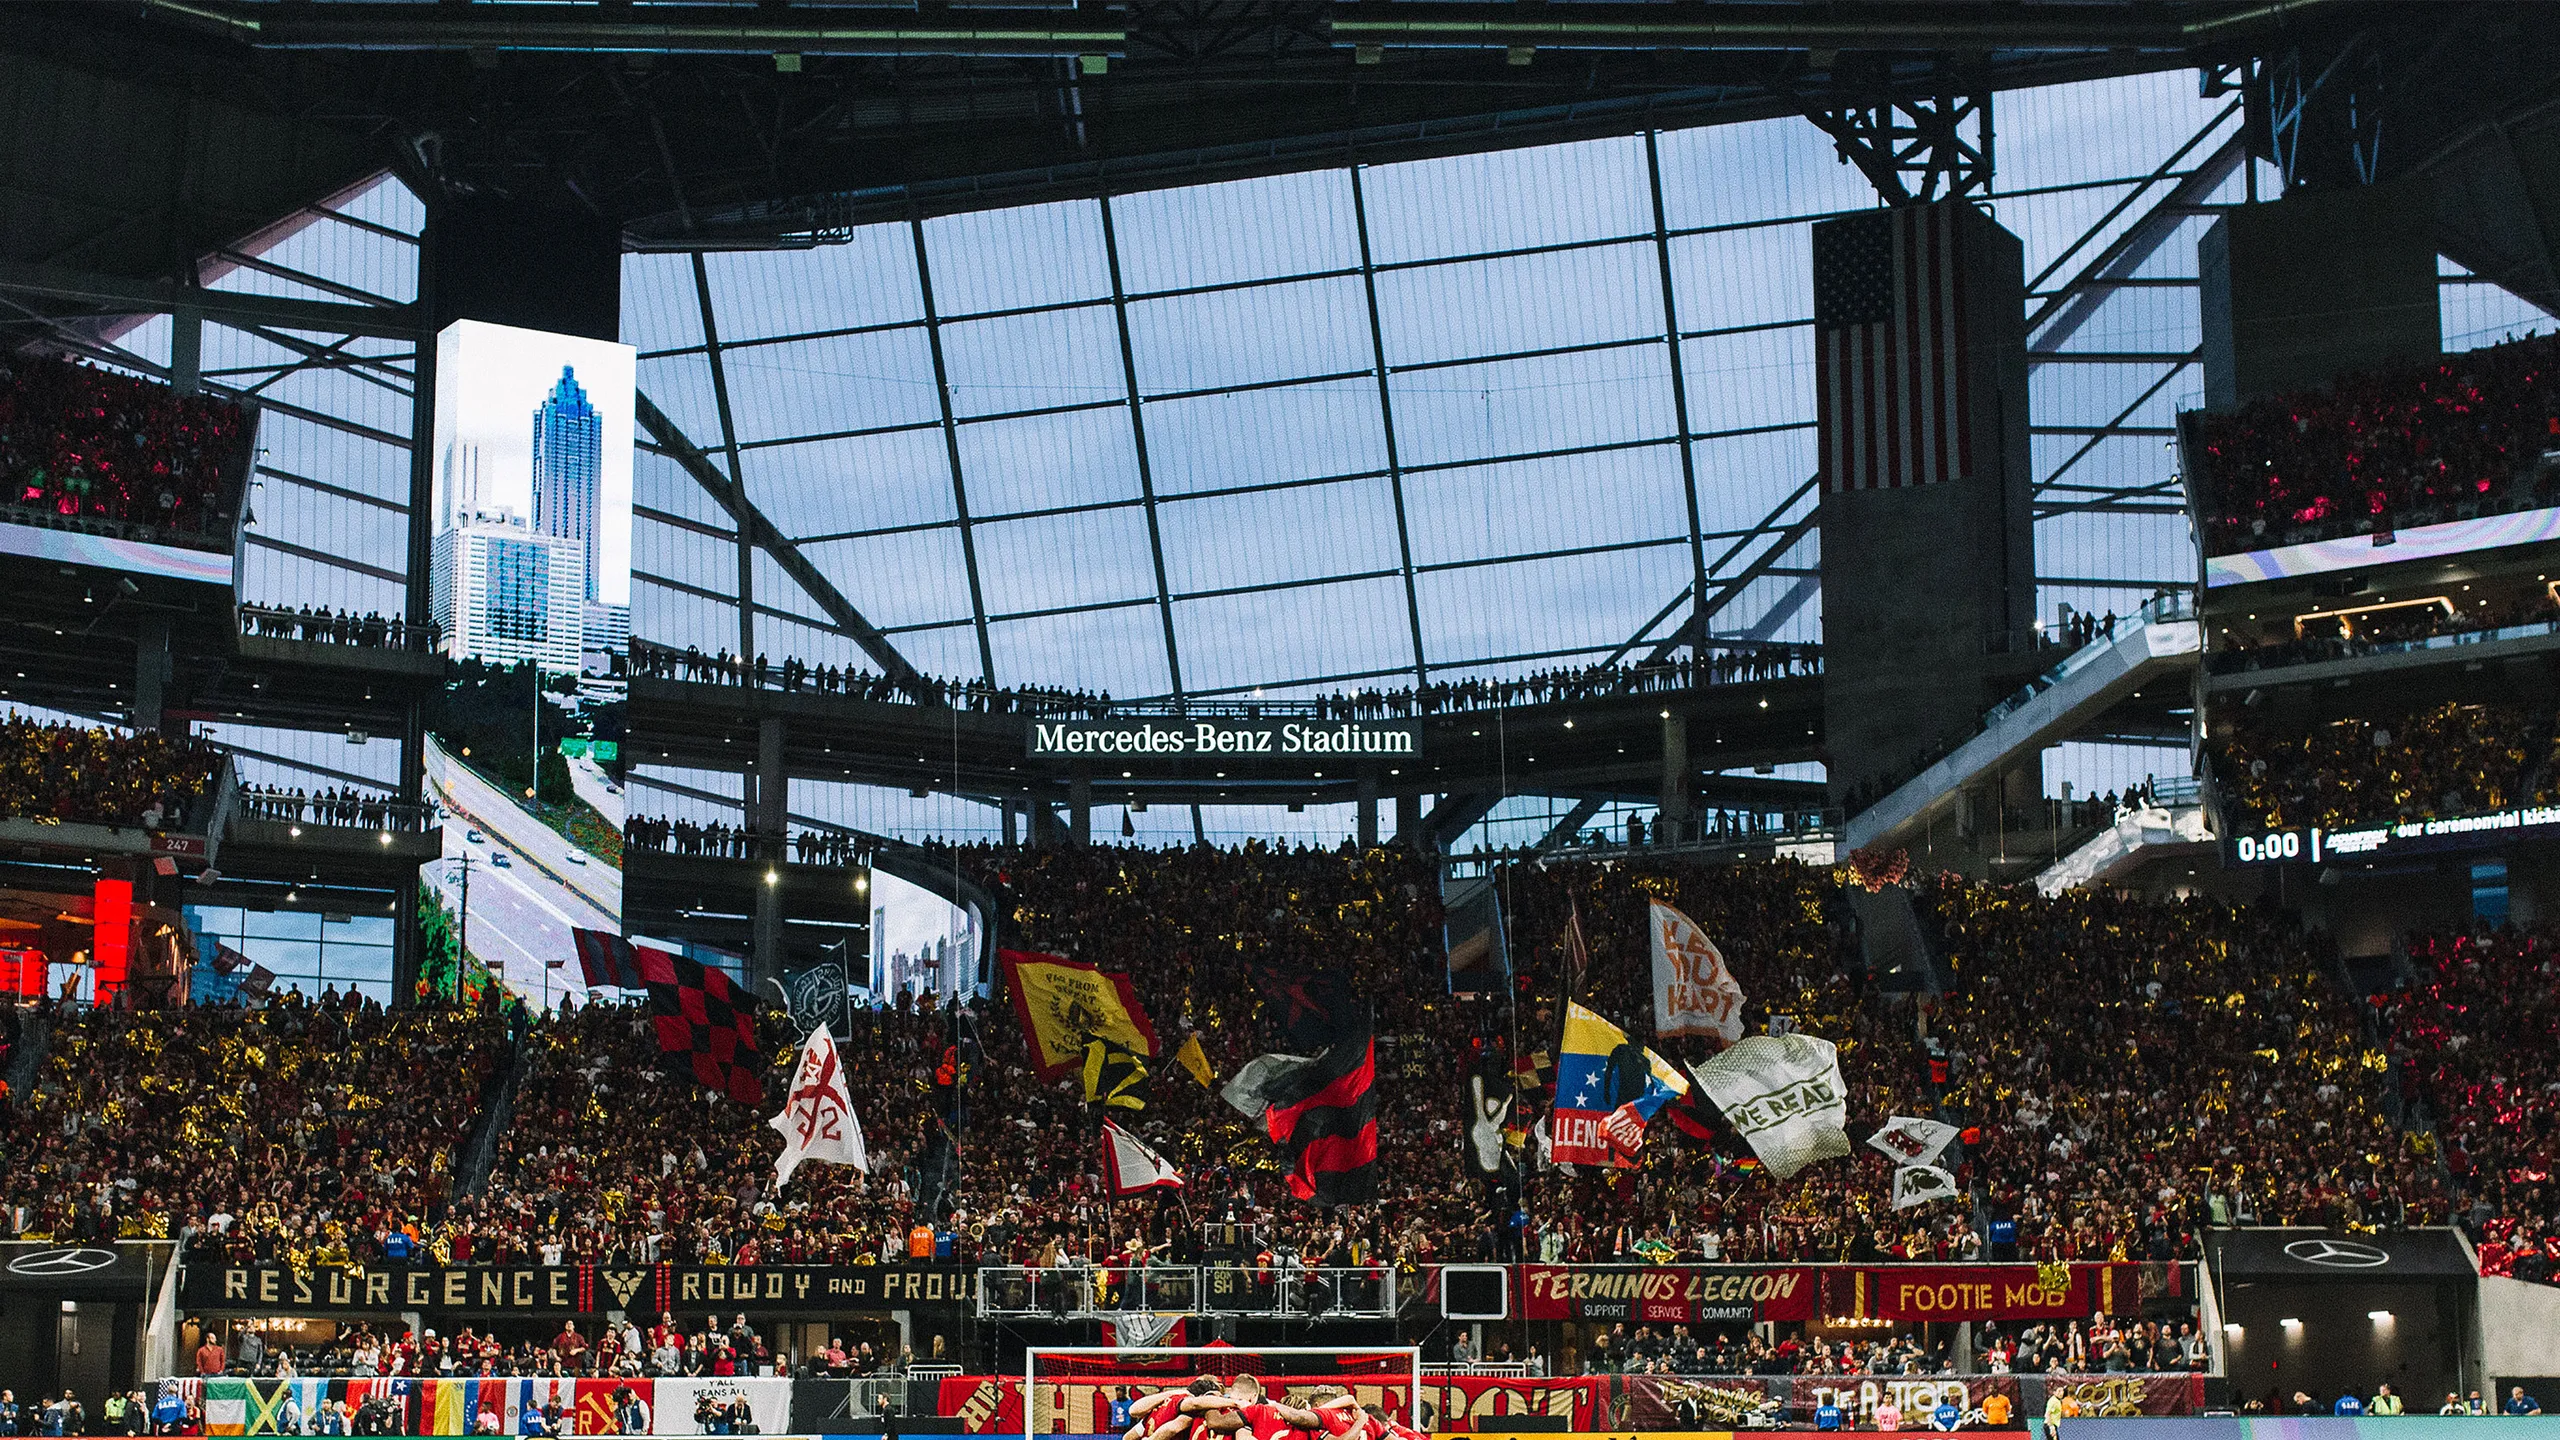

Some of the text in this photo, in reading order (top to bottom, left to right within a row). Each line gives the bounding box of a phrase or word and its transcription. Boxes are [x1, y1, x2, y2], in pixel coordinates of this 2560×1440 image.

[1034, 723, 1413, 753] Mercedes-Benz Stadium
[2397, 823, 2423, 838] our
[166, 839, 189, 851] 247
[2239, 832, 2299, 862] 0:00
[225, 1269, 569, 1306] RESURGENCE
[682, 1272, 810, 1300] ROWDY
[828, 1278, 865, 1295] AND
[1530, 1270, 1800, 1301] TERMINUS LEGION
[1900, 1283, 2067, 1312] FOOTIE MOB
[1584, 1304, 1627, 1318] SUPPORT
[1648, 1305, 1684, 1320] SERVICE
[1702, 1306, 1753, 1320] COMMUNITY
[692, 1388, 727, 1397] MEANS
[709, 1379, 736, 1387] Y'ALL
[2066, 1378, 2148, 1406] OOTIE
